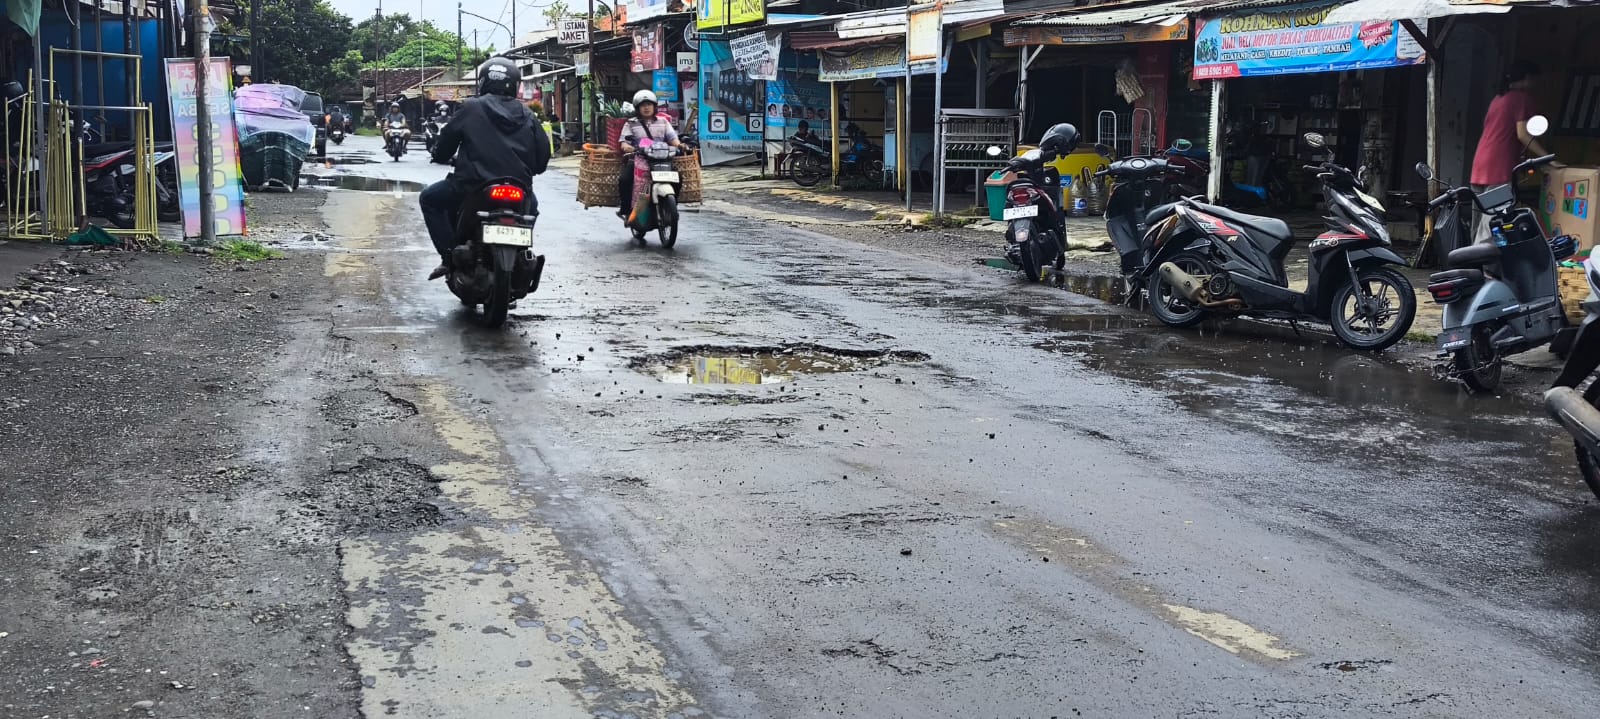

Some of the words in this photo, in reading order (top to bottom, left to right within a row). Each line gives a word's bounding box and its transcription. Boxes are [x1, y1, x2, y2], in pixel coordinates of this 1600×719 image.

[564, 21, 586, 30] ISTANA
[1220, 10, 1292, 33] ROHMAN
[560, 31, 586, 41] JAKET
[1221, 36, 1236, 50] JUAL
[1238, 35, 1251, 48] BELI
[1252, 33, 1278, 47] MOTOR
[1279, 31, 1303, 45] BEKAS
[1303, 24, 1353, 43] BERKUALITAS
